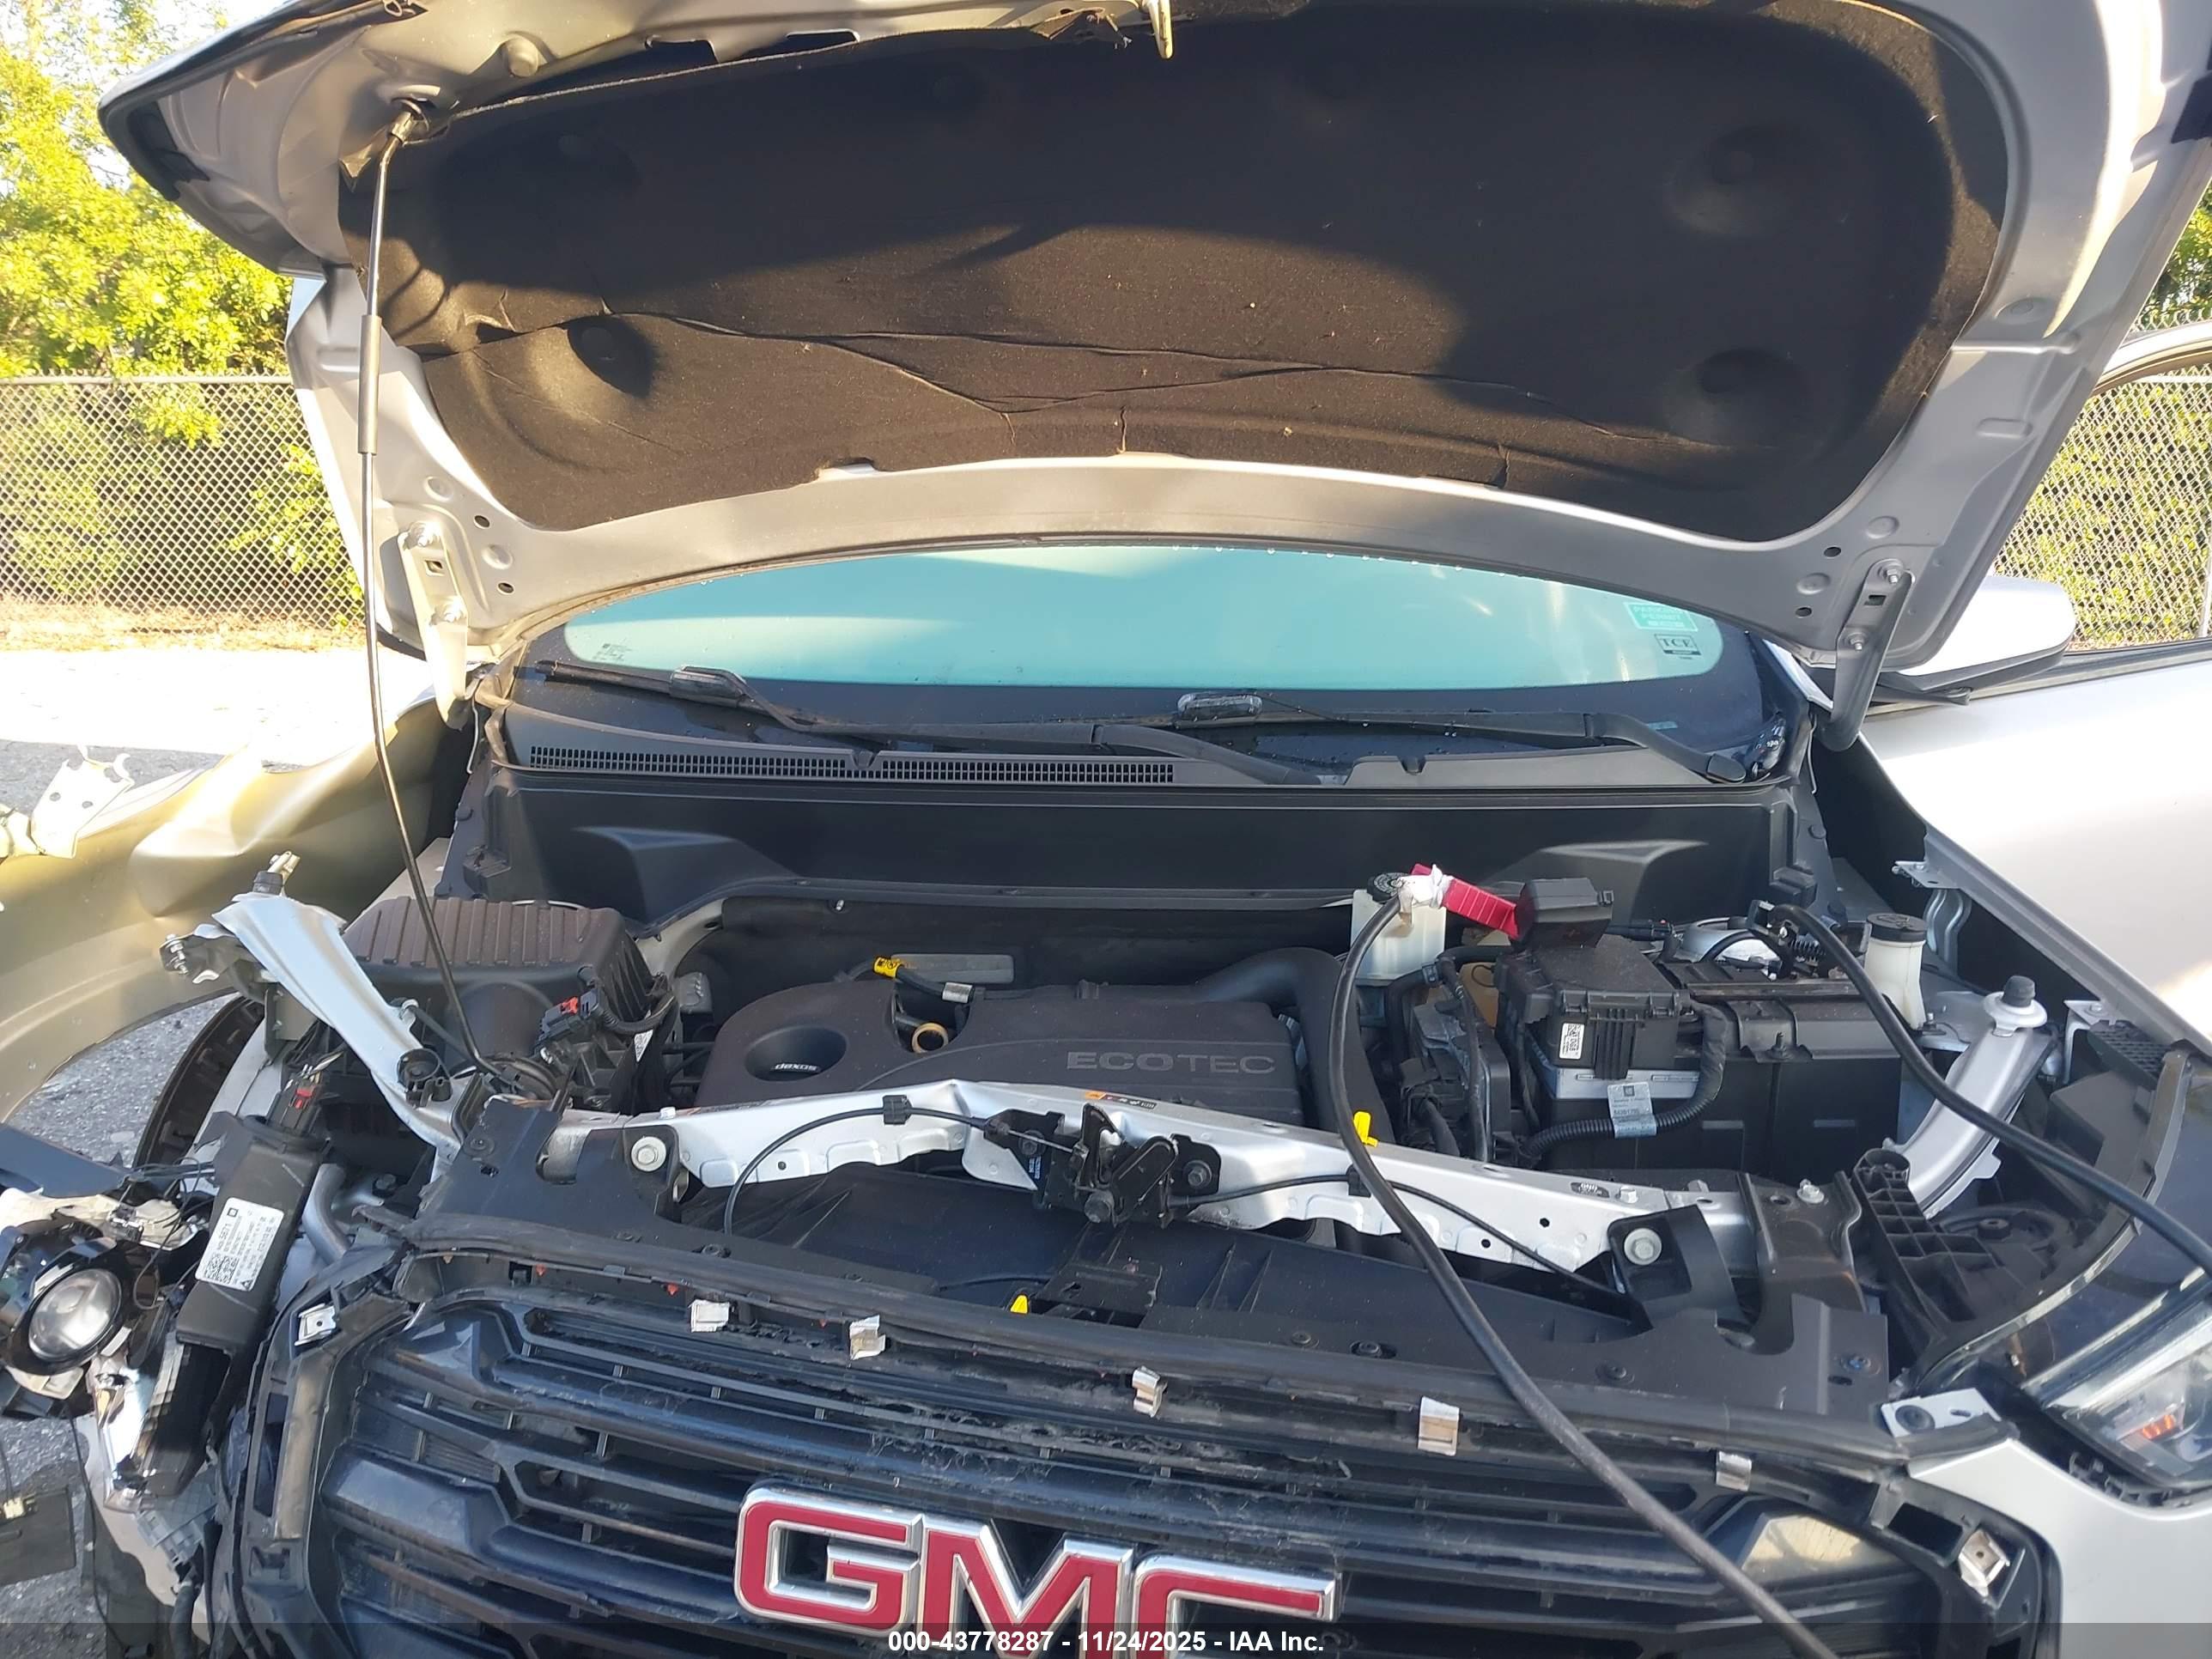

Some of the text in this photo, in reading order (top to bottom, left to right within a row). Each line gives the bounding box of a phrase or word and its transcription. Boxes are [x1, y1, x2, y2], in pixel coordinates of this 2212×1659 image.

[774, 1062, 820, 1072] dexos
[1066, 1051, 1276, 1074] ECOTEC
[734, 1486, 1341, 1659] GMC
